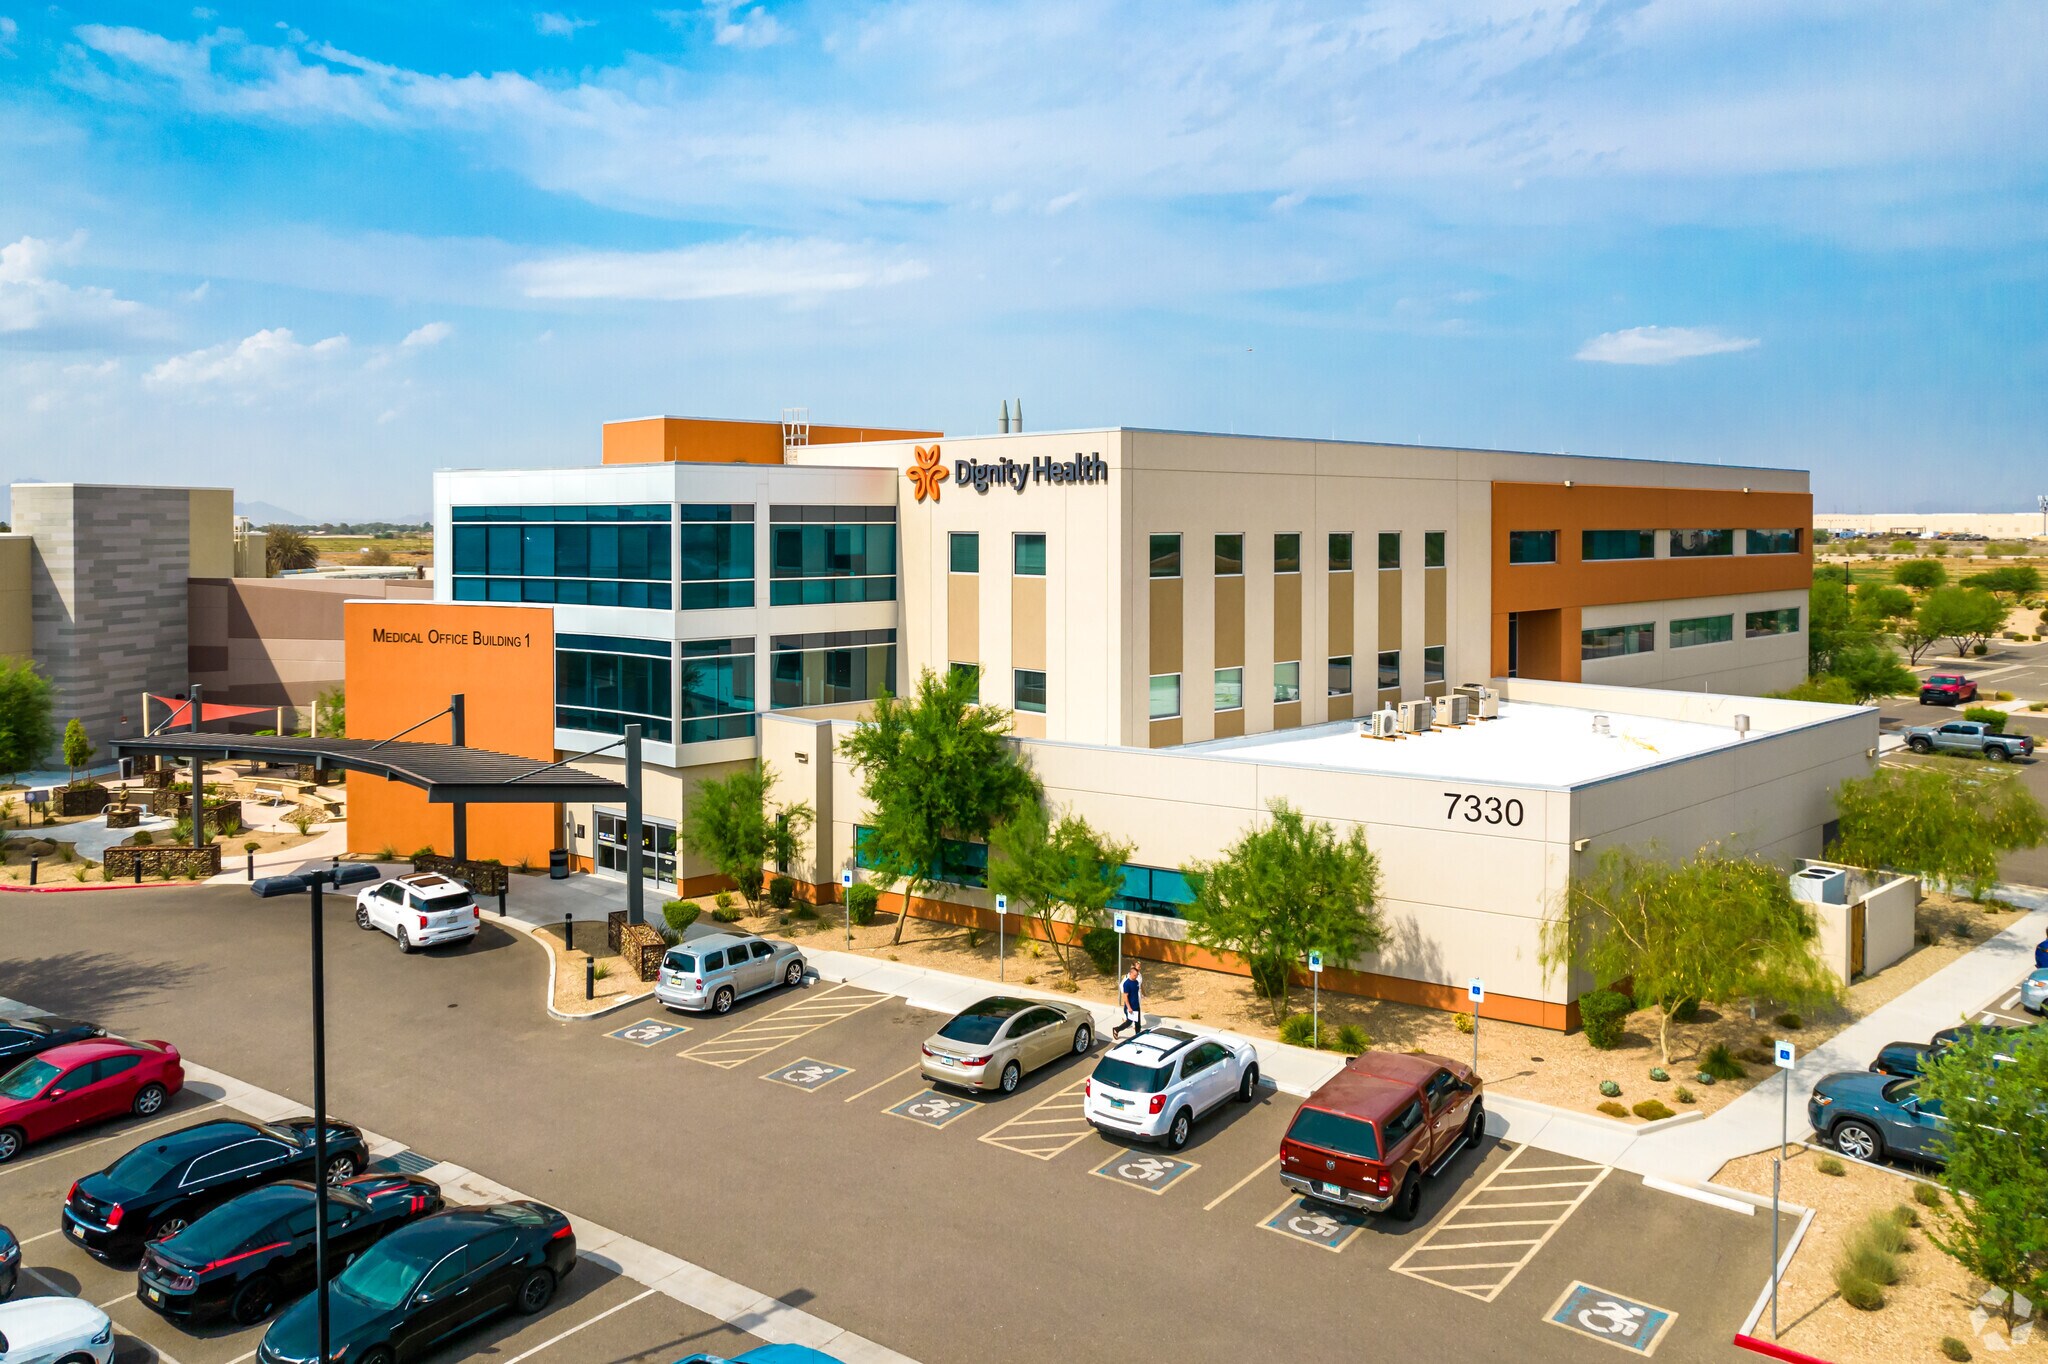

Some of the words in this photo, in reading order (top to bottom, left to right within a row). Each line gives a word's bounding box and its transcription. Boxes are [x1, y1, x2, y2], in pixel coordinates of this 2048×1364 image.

[955, 457, 1030, 492] Dignity
[1033, 452, 1108, 483] Health
[373, 628, 423, 644] MEDICAL
[428, 629, 468, 645] OFFICE
[473, 631, 521, 647] BUILDING
[524, 633, 530, 648] 1
[1444, 793, 1524, 827] 7330
